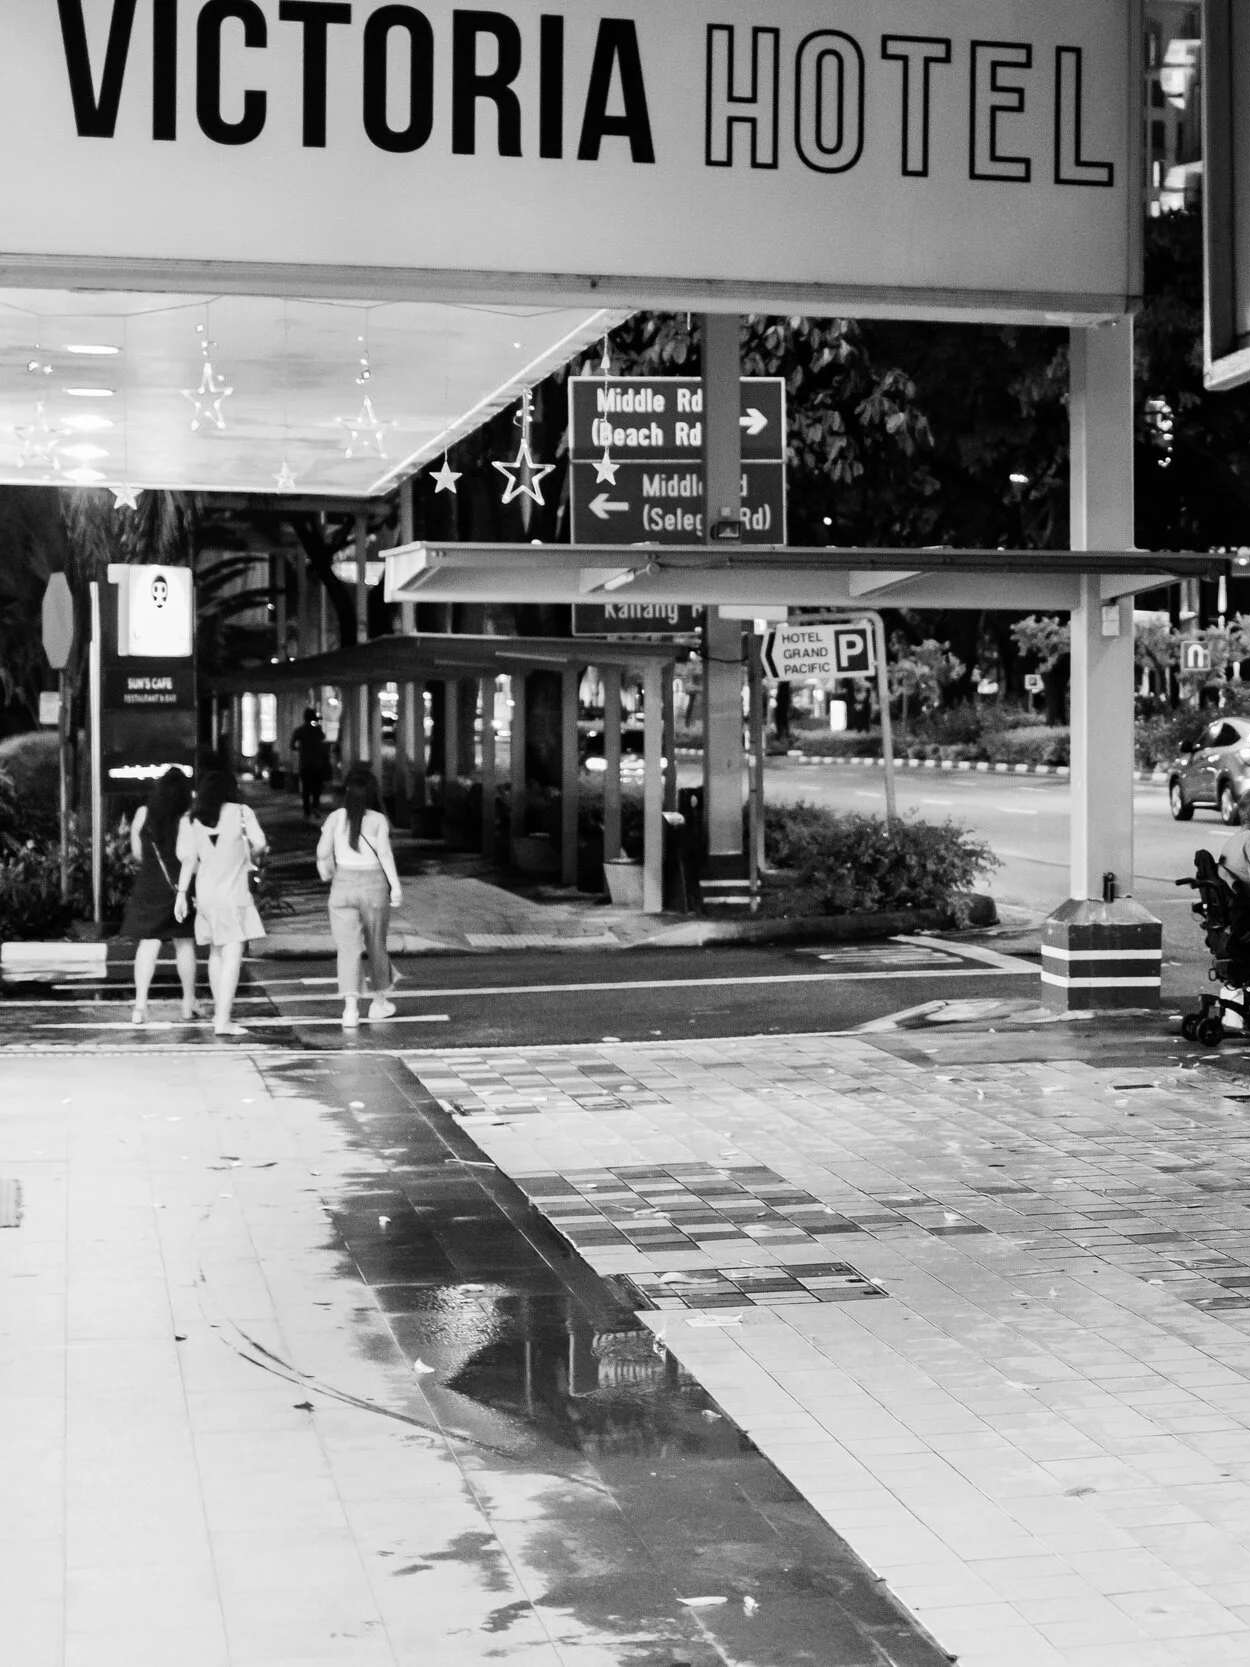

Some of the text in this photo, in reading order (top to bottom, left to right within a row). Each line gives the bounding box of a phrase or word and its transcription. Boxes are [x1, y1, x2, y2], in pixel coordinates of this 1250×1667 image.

[57, 0, 1115, 188] VICTORIA HOTEL
[596, 388, 703, 413] Middle Rd
[592, 418, 702, 447] (Beach Rd
[642, 503, 703, 537] (Seleg
[782, 632, 823, 644] HOTEL
[838, 633, 864, 668] P
[783, 647, 828, 659] GRAND
[784, 662, 831, 675] PACIFIC
